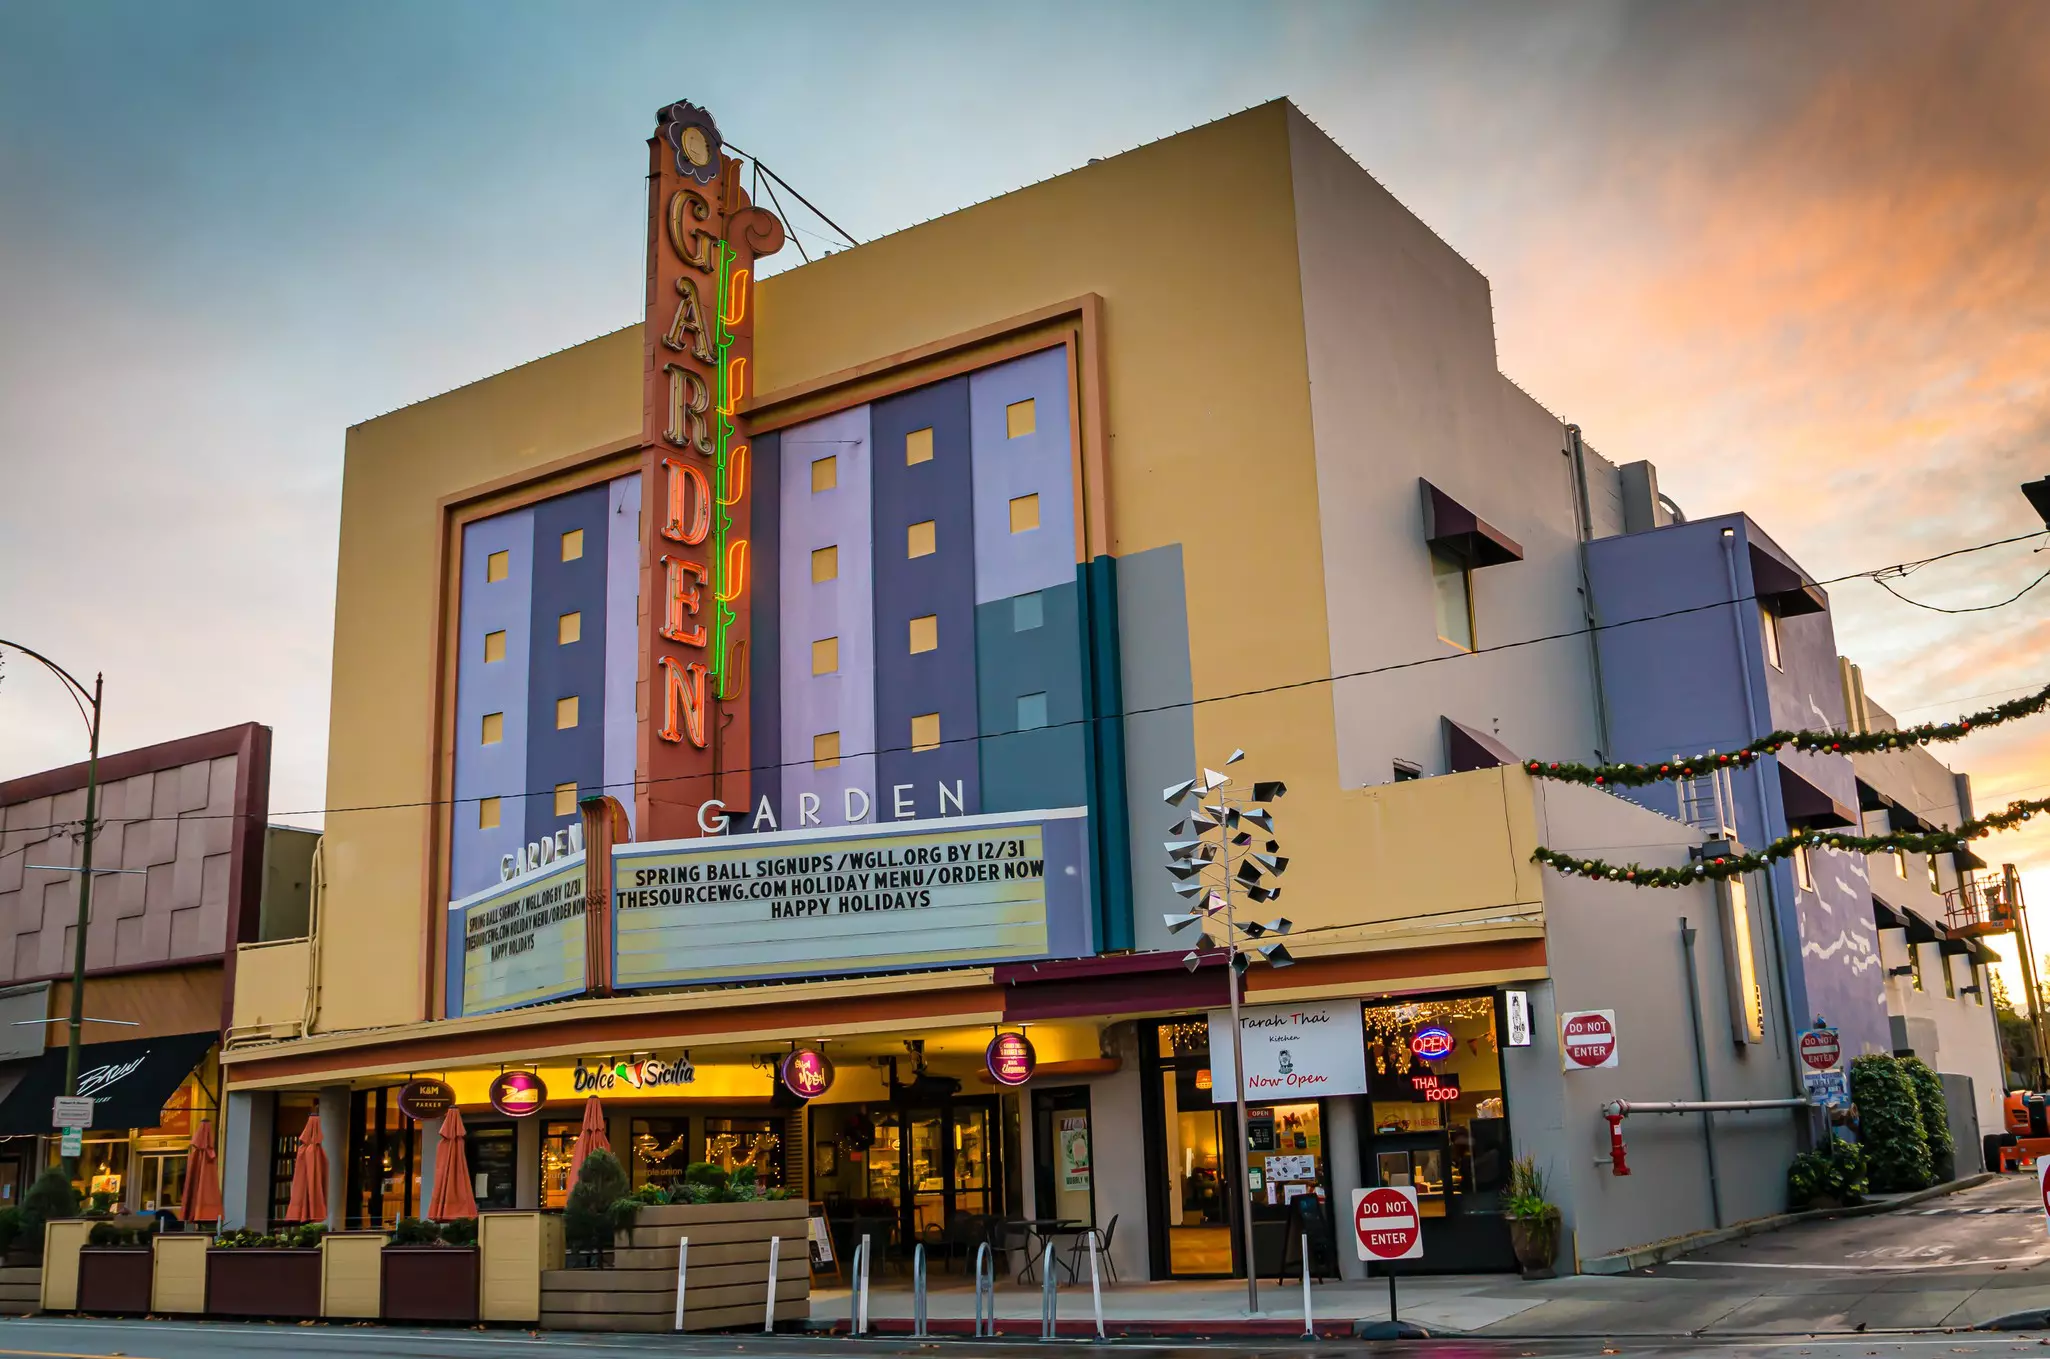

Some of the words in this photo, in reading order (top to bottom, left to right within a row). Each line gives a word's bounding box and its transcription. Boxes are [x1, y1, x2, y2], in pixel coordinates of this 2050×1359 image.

[658, 188, 718, 750] GARDEN
[697, 780, 965, 833] GARDEN
[501, 823, 584, 883] GARDEN
[635, 865, 700, 887] SPRING
[706, 861, 752, 882] BALL
[756, 855, 833, 878] SIGNUPS
[947, 843, 972, 862] BY
[977, 839, 1025, 860] 12/31
[616, 879, 787, 909] THESOURCEWG.COM
[791, 873, 870, 897] HOLIDAY
[873, 863, 1000, 888] MENU/ORDER
[1004, 859, 1044, 879] NOW
[771, 897, 831, 919] HAPPY
[838, 890, 931, 914] HOLIDAYS
[1240, 1014, 1288, 1029] Tarah
[1290, 1010, 1331, 1025] Thai
[1570, 1023, 1583, 1033] DO
[1587, 1021, 1607, 1032] NOT
[1269, 1034, 1301, 1043] Kitchen
[1412, 1036, 1451, 1052] OPEN
[1805, 1038, 1816, 1046] DO
[1818, 1036, 1833, 1045] NOT
[1574, 1046, 1606, 1057] ENTER
[1808, 1053, 1835, 1063] ENTER
[574, 1063, 615, 1092] Dolce
[645, 1057, 695, 1086] Sicilia
[1249, 1074, 1284, 1088] Now
[1285, 1073, 1328, 1089] Open
[1412, 1077, 1438, 1089] THAI
[419, 1086, 439, 1095] K&M
[1426, 1088, 1459, 1101] FOOD
[1363, 1202, 1379, 1214] DO
[1385, 1201, 1407, 1213] NOT
[1371, 1232, 1407, 1245] ENTER
